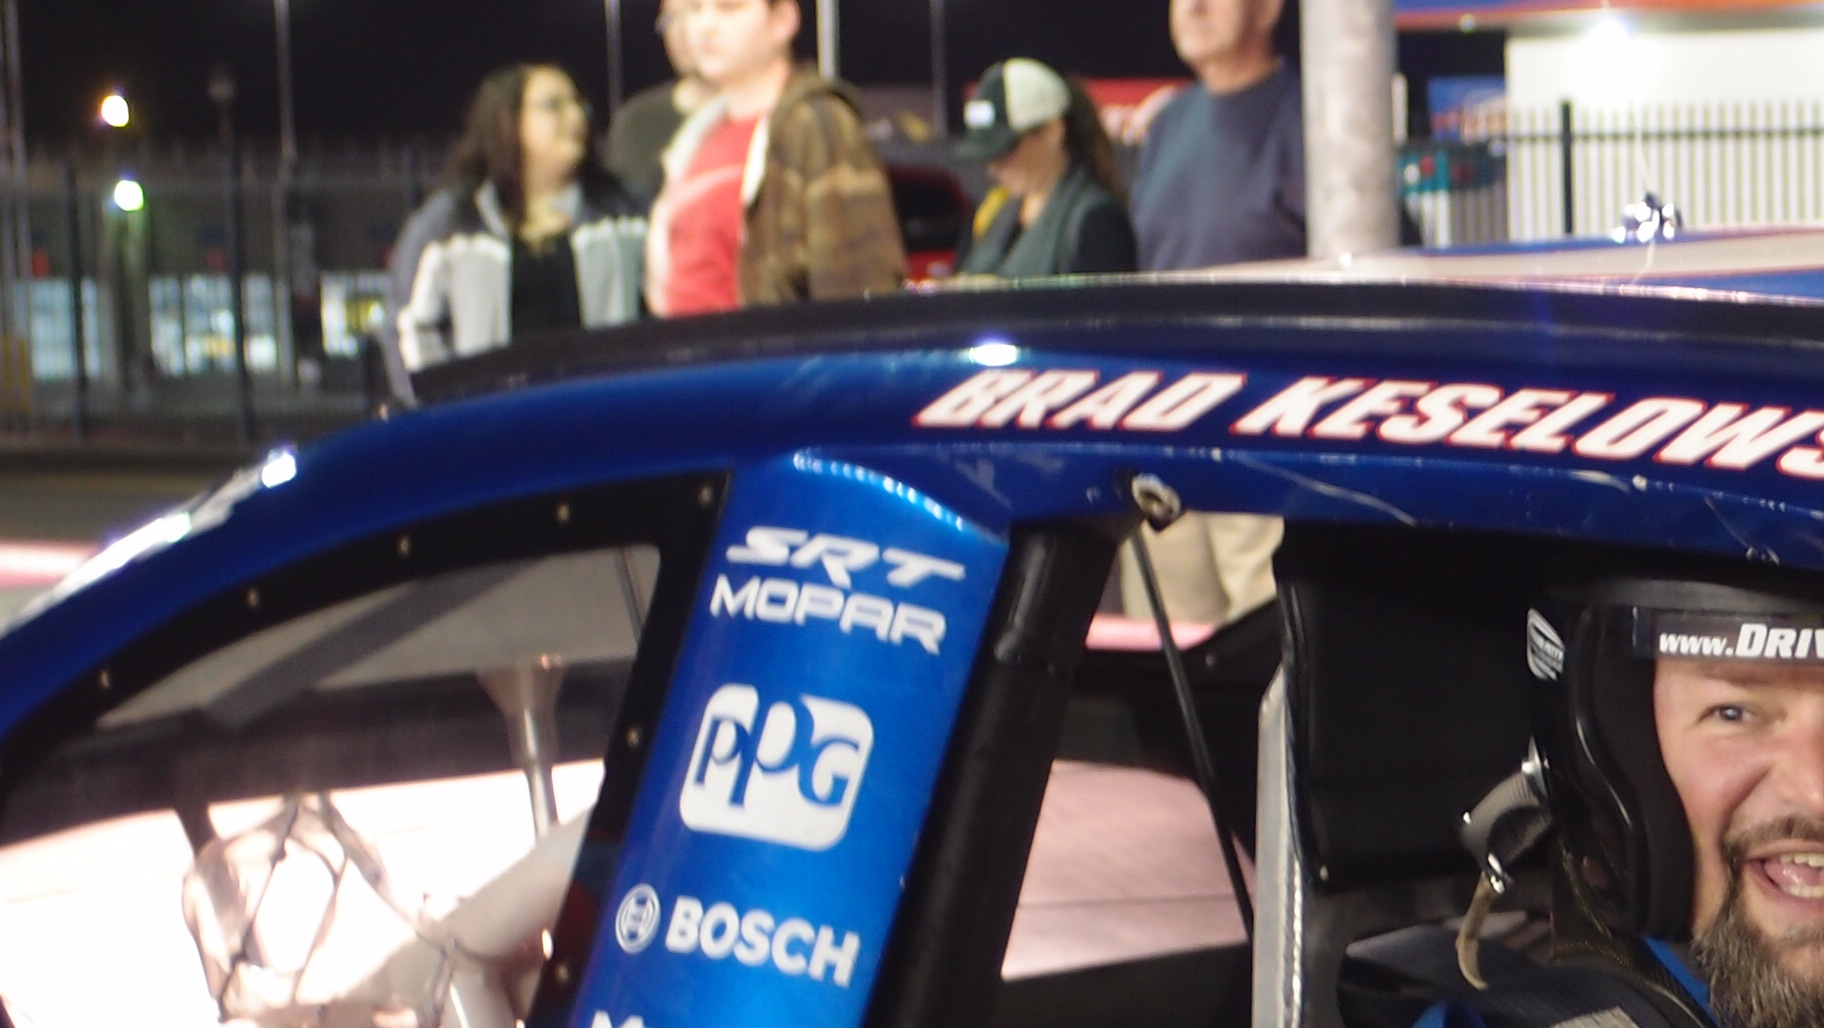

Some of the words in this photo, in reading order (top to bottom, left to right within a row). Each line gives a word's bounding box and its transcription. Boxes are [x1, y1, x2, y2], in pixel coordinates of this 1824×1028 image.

[912, 368, 1248, 430] BRAD
[725, 525, 966, 589] SRT
[709, 572, 947, 656] MOPAR
[664, 895, 860, 988] BOSCH
